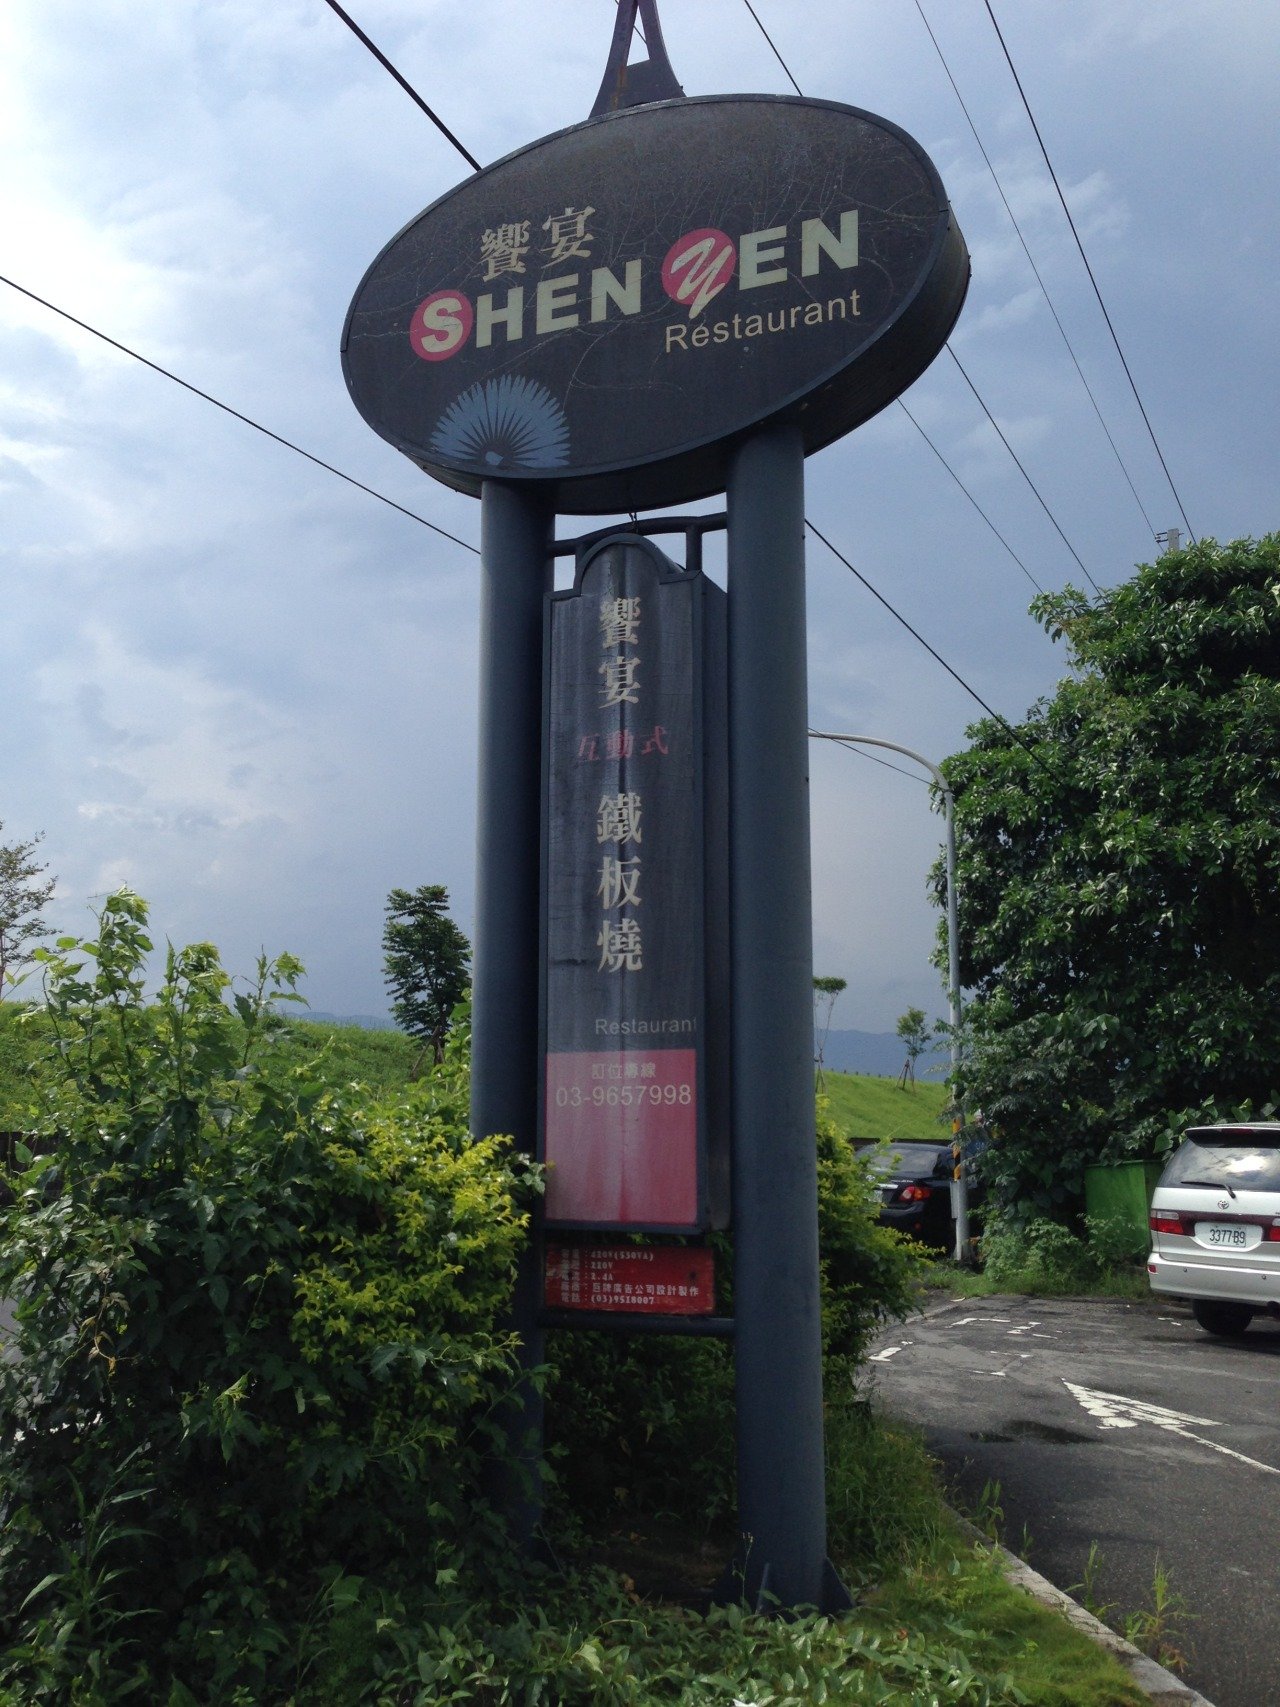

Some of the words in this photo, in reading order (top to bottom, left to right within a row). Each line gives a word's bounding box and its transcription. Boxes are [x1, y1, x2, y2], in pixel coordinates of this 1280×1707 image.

[480, 205, 596, 283] 饗宴
[421, 259, 642, 355] SHEN
[665, 288, 861, 353] Restaurant
[598, 596, 642, 708] 饗宴
[597, 792, 643, 972] 鐵板燒
[556, 1085, 692, 1107] 03-9657998
